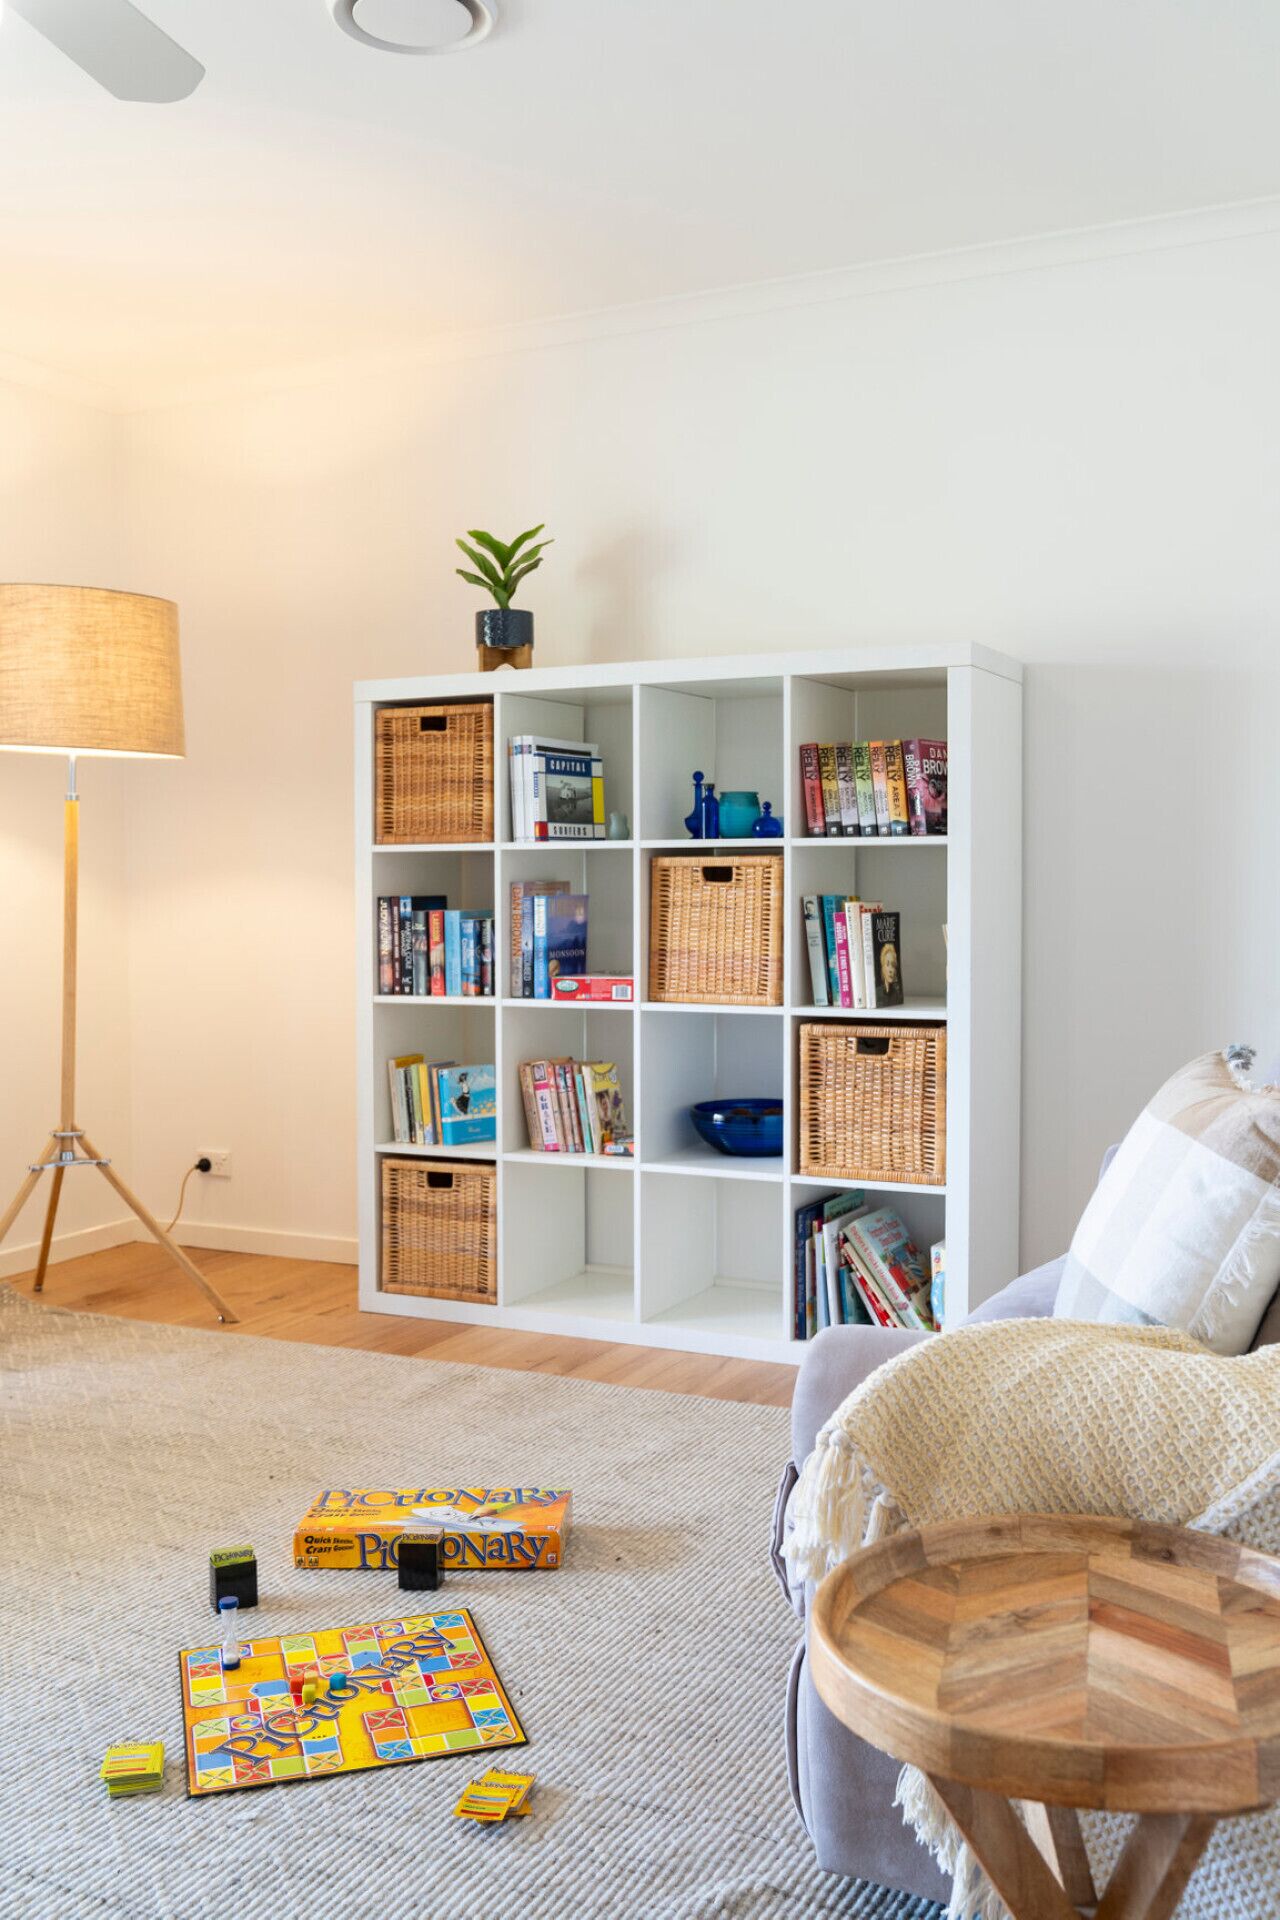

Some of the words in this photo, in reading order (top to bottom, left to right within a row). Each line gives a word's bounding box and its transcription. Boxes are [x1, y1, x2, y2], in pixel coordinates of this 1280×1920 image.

[549, 759, 586, 773] CAPITAL
[819, 747, 834, 782] REILLY
[836, 747, 850, 783] REILLY
[853, 746, 866, 781] REILLY
[884, 746, 898, 782] REILLY
[904, 754, 917, 789] BROWN
[892, 785, 901, 810] AREA
[512, 886, 522, 911] DAN
[512, 913, 522, 957] BROWN
[876, 917, 897, 930] MARIE
[877, 929, 897, 942] CURIE
[549, 948, 585, 959] MONSOON
[304, 1535, 332, 1545] Quick
[305, 1545, 332, 1555] Crazy
